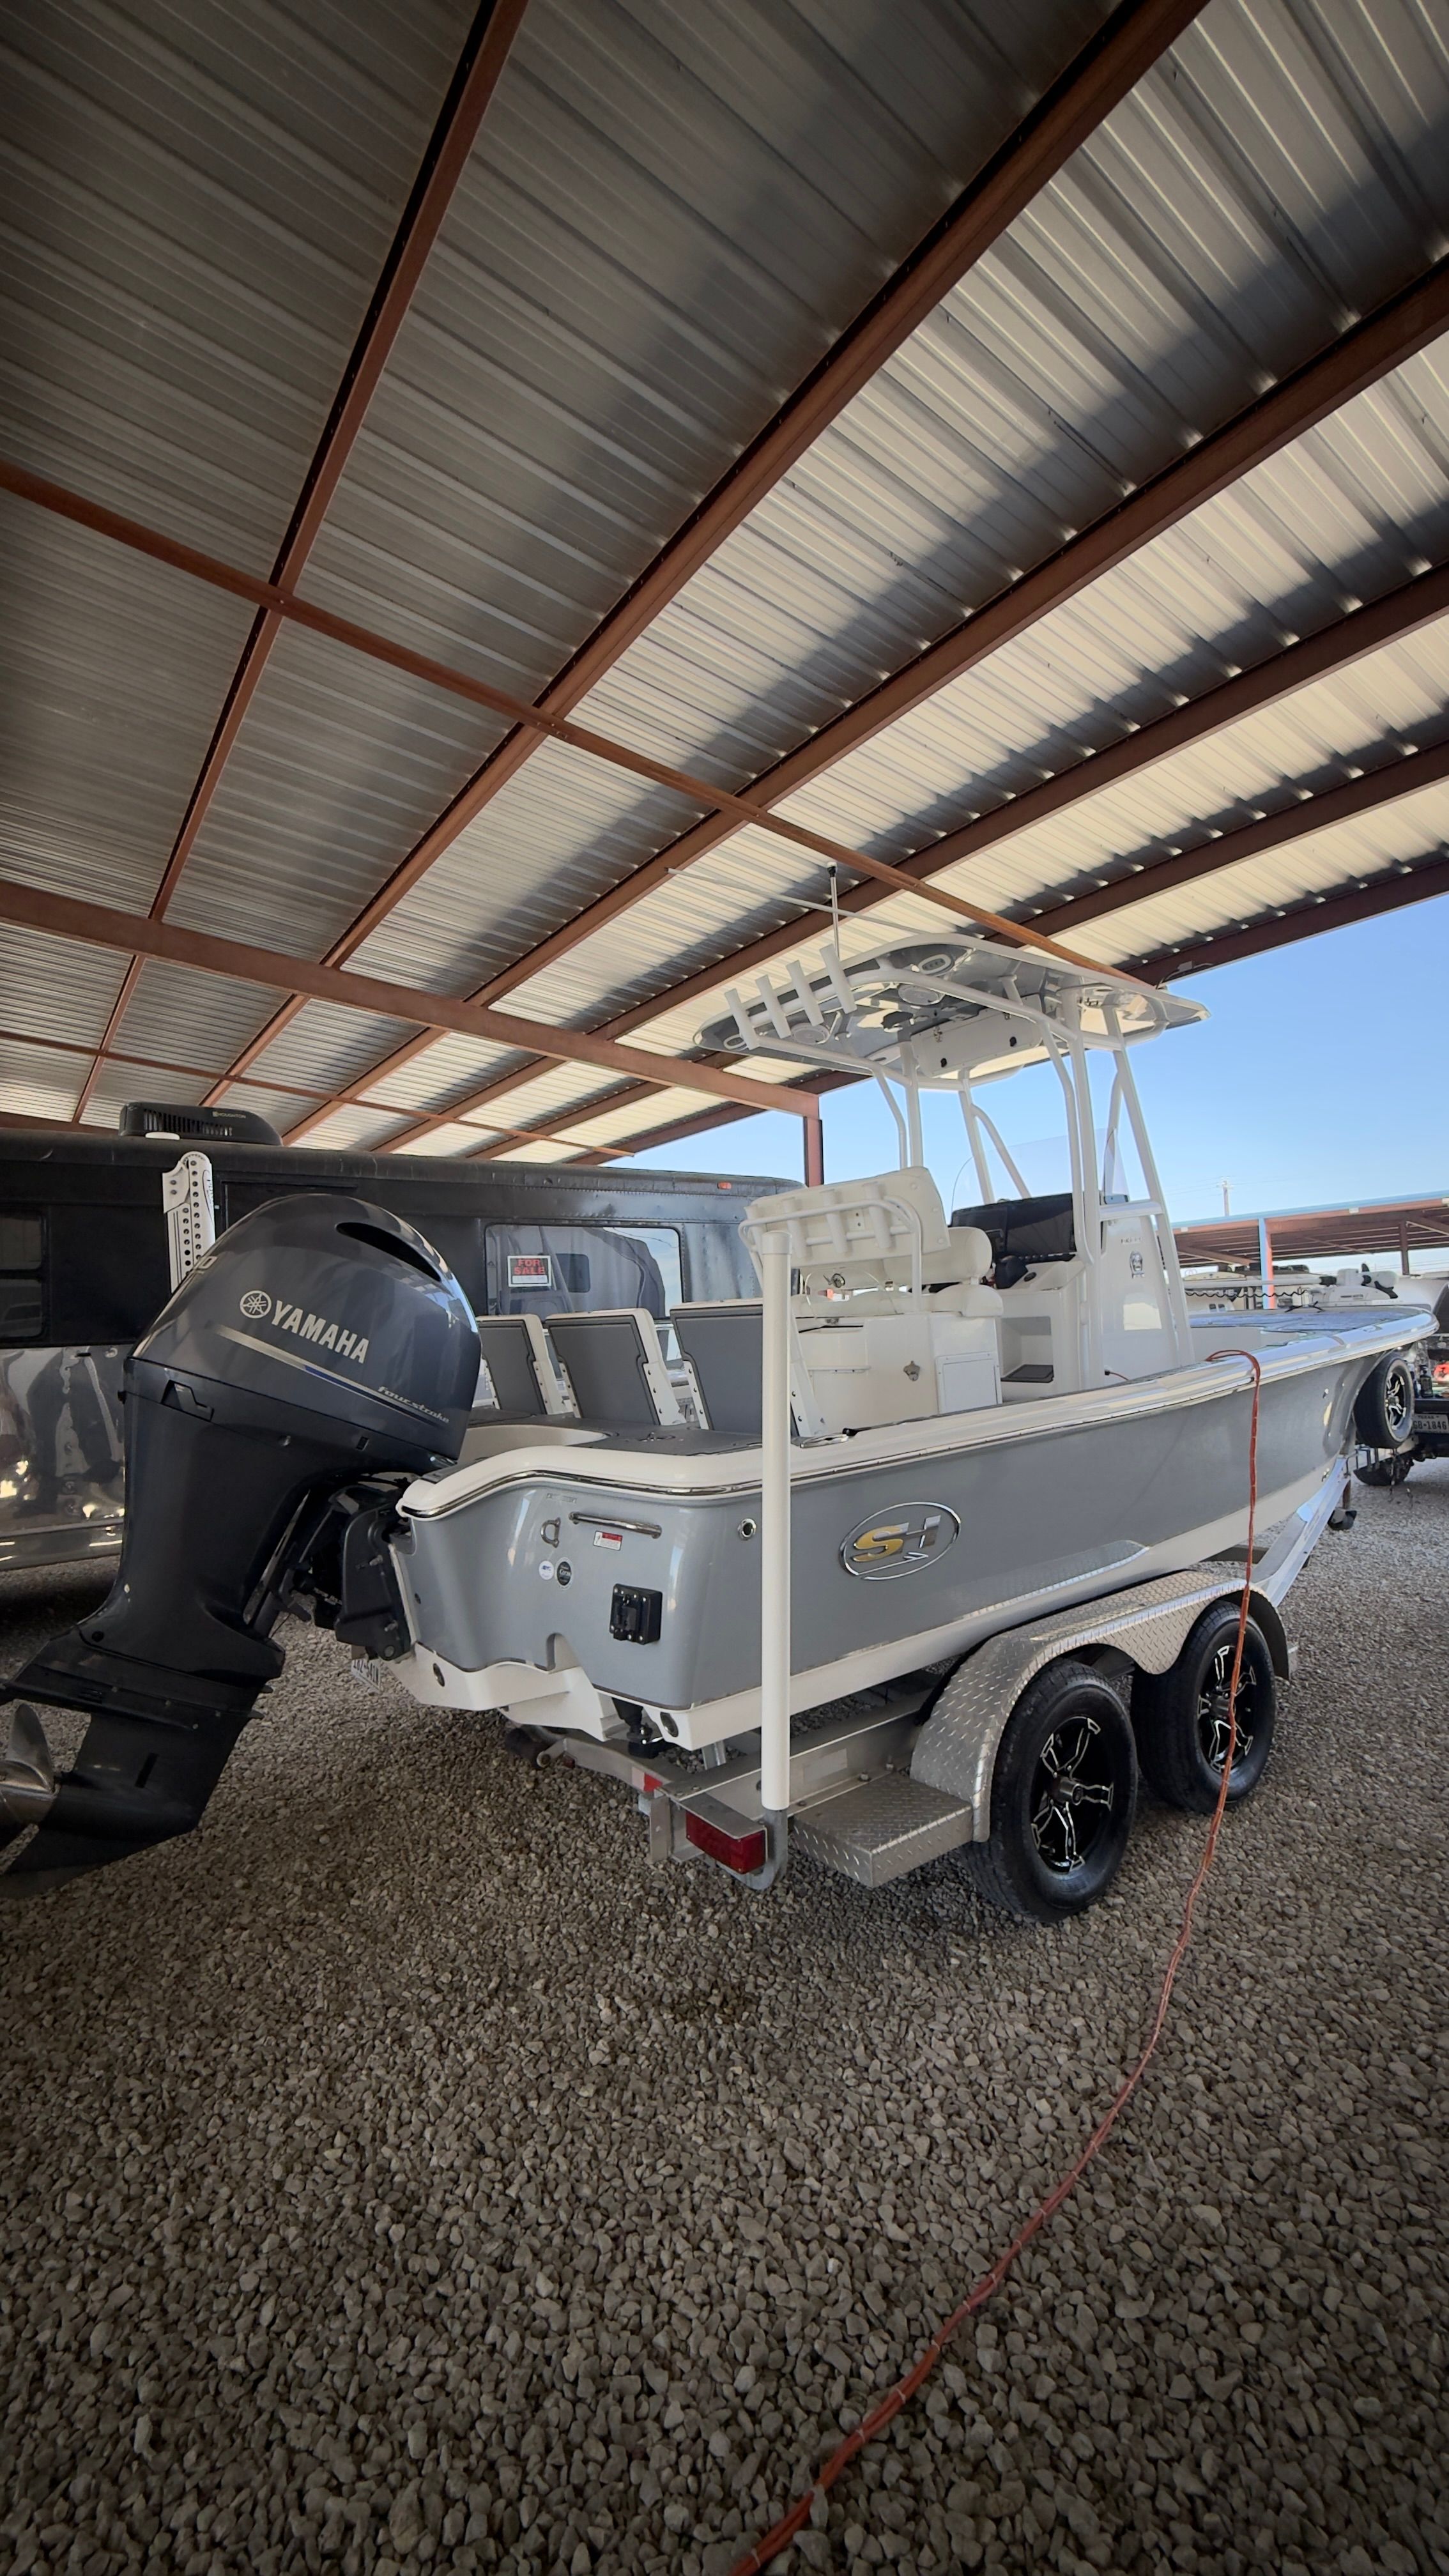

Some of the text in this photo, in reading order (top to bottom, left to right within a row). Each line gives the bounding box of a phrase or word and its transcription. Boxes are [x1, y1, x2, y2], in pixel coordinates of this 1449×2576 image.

[518, 1259, 540, 1267] FOR
[514, 1266, 546, 1275] SALE
[271, 1300, 370, 1365] YAMAHA
[1413, 1420, 1447, 1430] GB-1846
